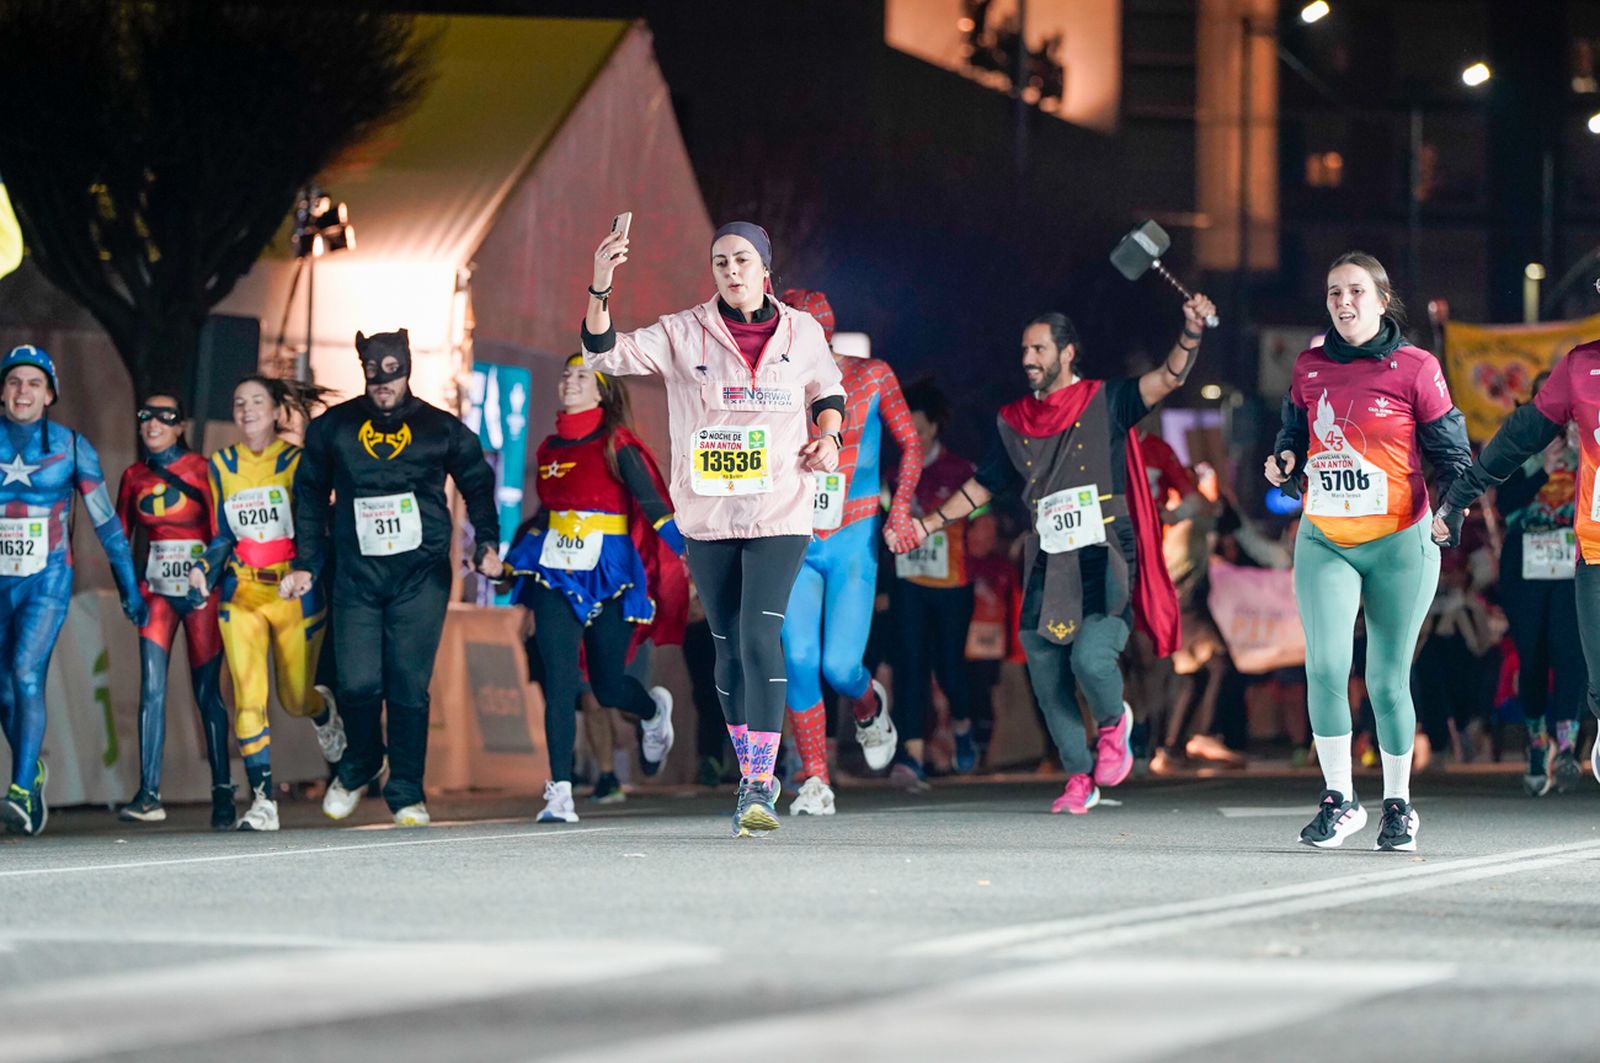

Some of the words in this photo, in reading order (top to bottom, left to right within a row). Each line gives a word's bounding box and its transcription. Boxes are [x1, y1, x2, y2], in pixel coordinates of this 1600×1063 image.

[744, 387, 792, 400] NORWAY
[700, 441, 715, 449] SAN
[709, 432, 731, 441] NOCHE
[732, 433, 742, 441] DE
[1325, 430, 1343, 451] 43
[700, 450, 761, 472] 13536
[1320, 470, 1370, 491] 5708
[238, 507, 280, 526] 6204
[1053, 511, 1081, 531] 307
[375, 517, 401, 535] 311
[162, 561, 192, 578] 309
[752, 742, 773, 756] ONE
